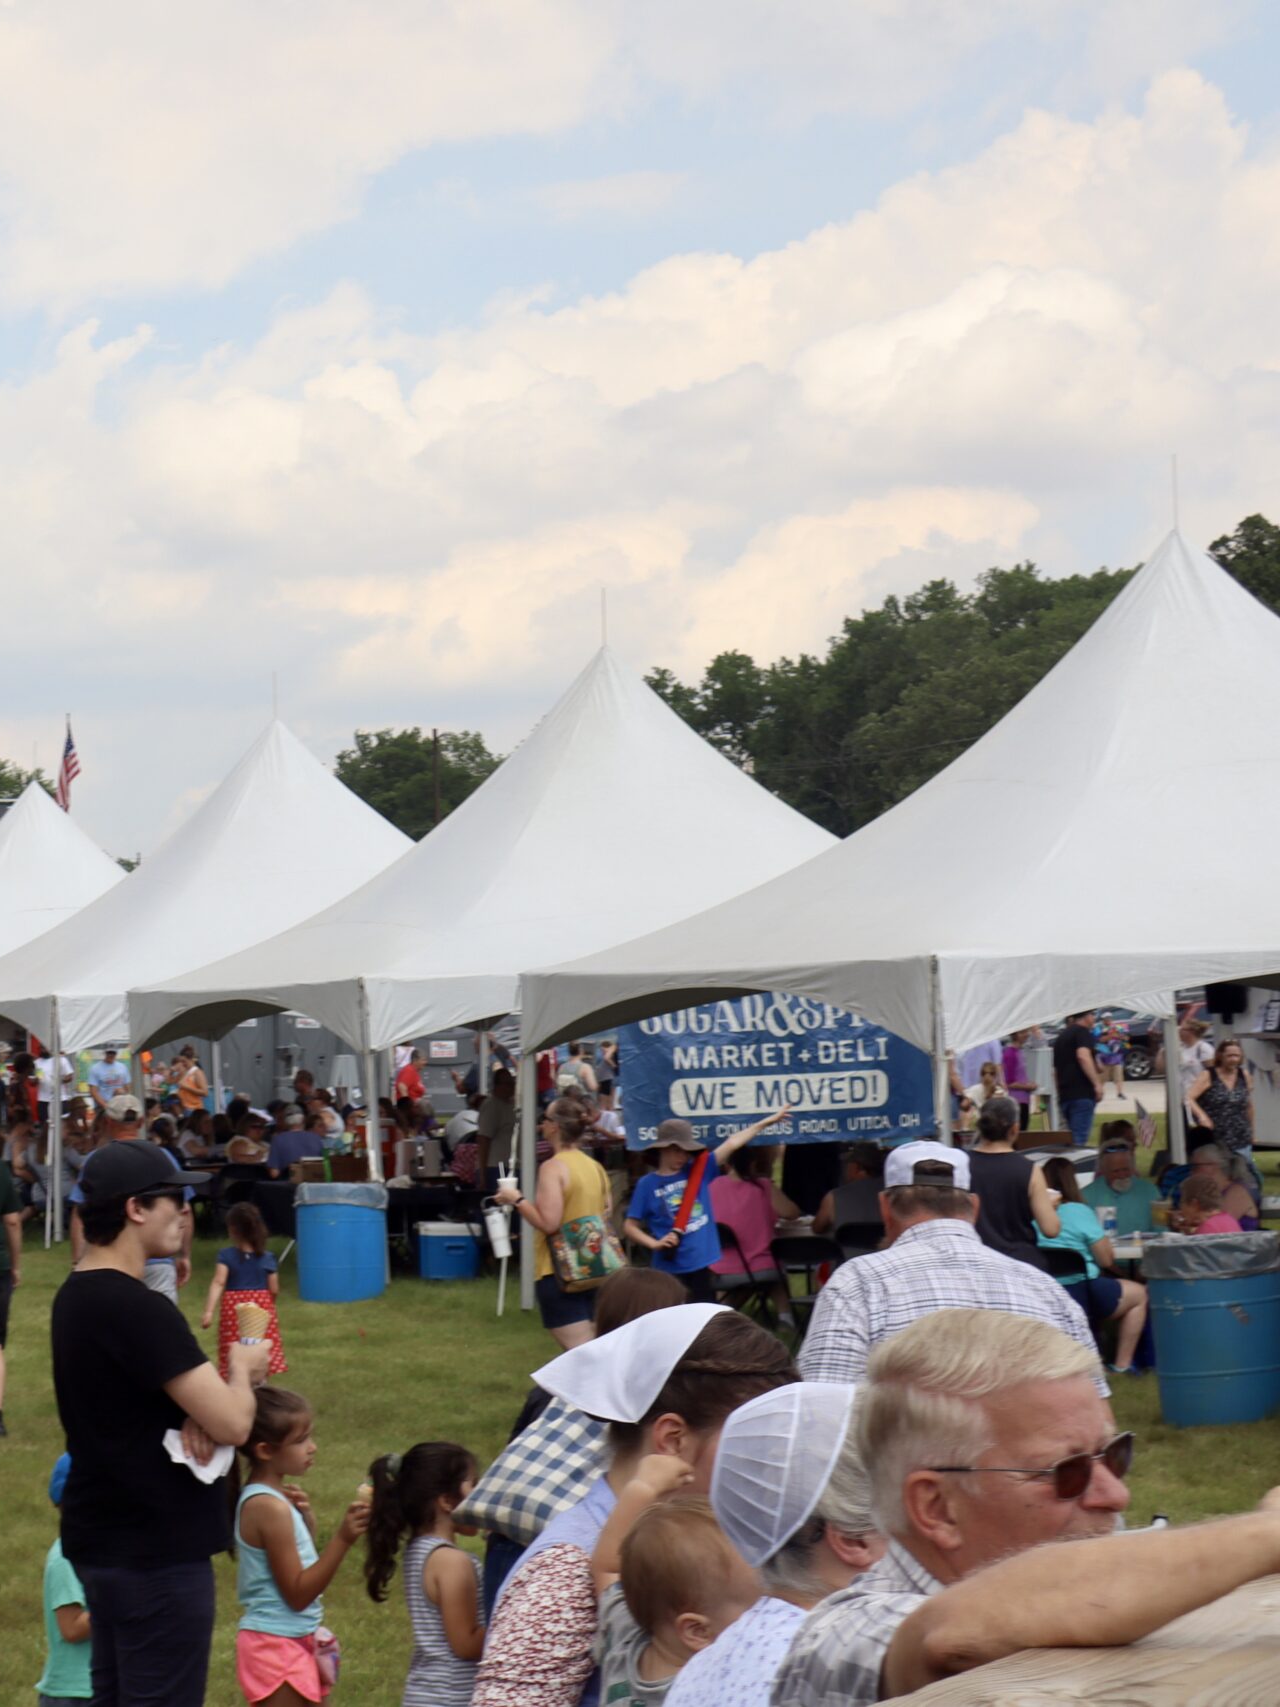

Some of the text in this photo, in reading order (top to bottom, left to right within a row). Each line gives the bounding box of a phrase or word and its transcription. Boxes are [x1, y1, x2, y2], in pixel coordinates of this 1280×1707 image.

[673, 1037, 889, 1071] MARKET + DELI
[681, 1074, 879, 1111] WE MOVED!
[691, 1124, 710, 1139] ST
[715, 1120, 794, 1138] COLUBUS
[898, 1113, 920, 1127] OH
